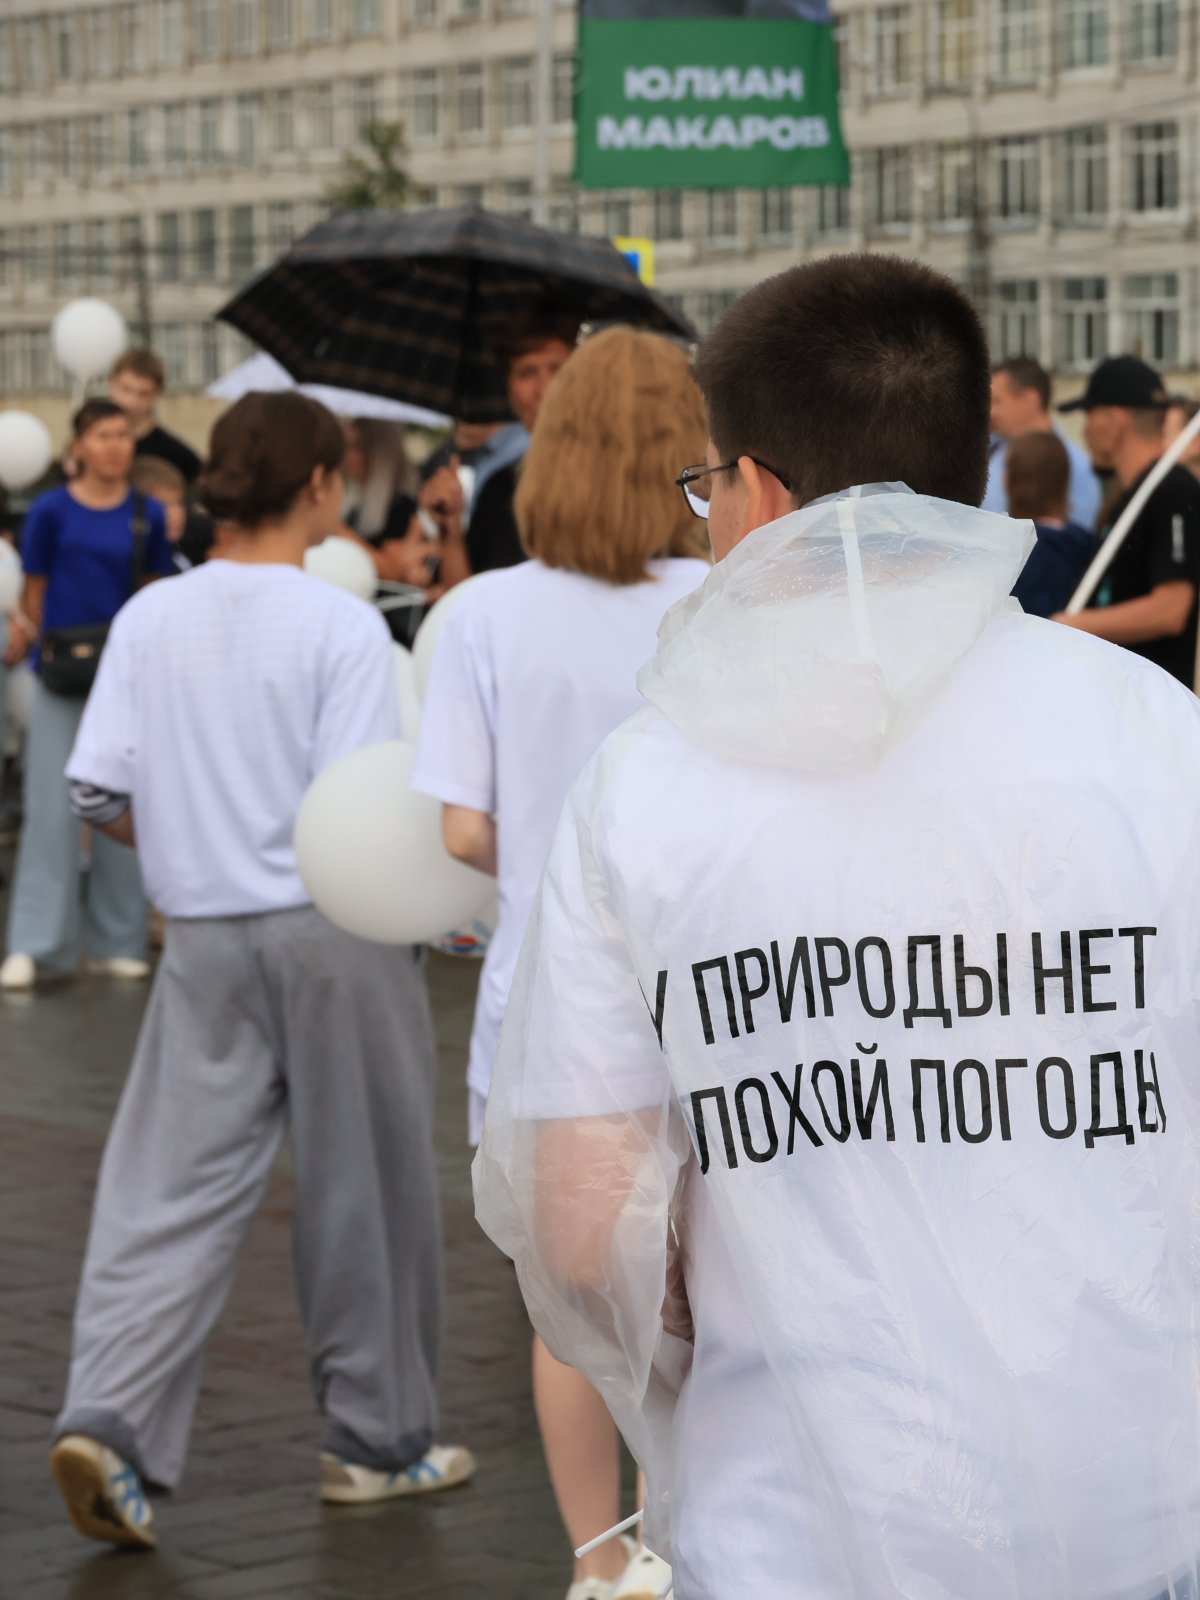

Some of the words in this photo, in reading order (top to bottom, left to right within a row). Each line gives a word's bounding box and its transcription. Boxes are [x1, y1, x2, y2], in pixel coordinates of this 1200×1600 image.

[623, 66, 804, 101] ЮЛИАН
[597, 115, 830, 150] МАКАРОВ
[690, 933, 1012, 1047] ПРИРОДЫ
[1031, 926, 1158, 1016] НЕТ
[690, 1042, 897, 1177] ЛОХОЙ
[909, 1049, 1168, 1150] ПОГОДЫ
